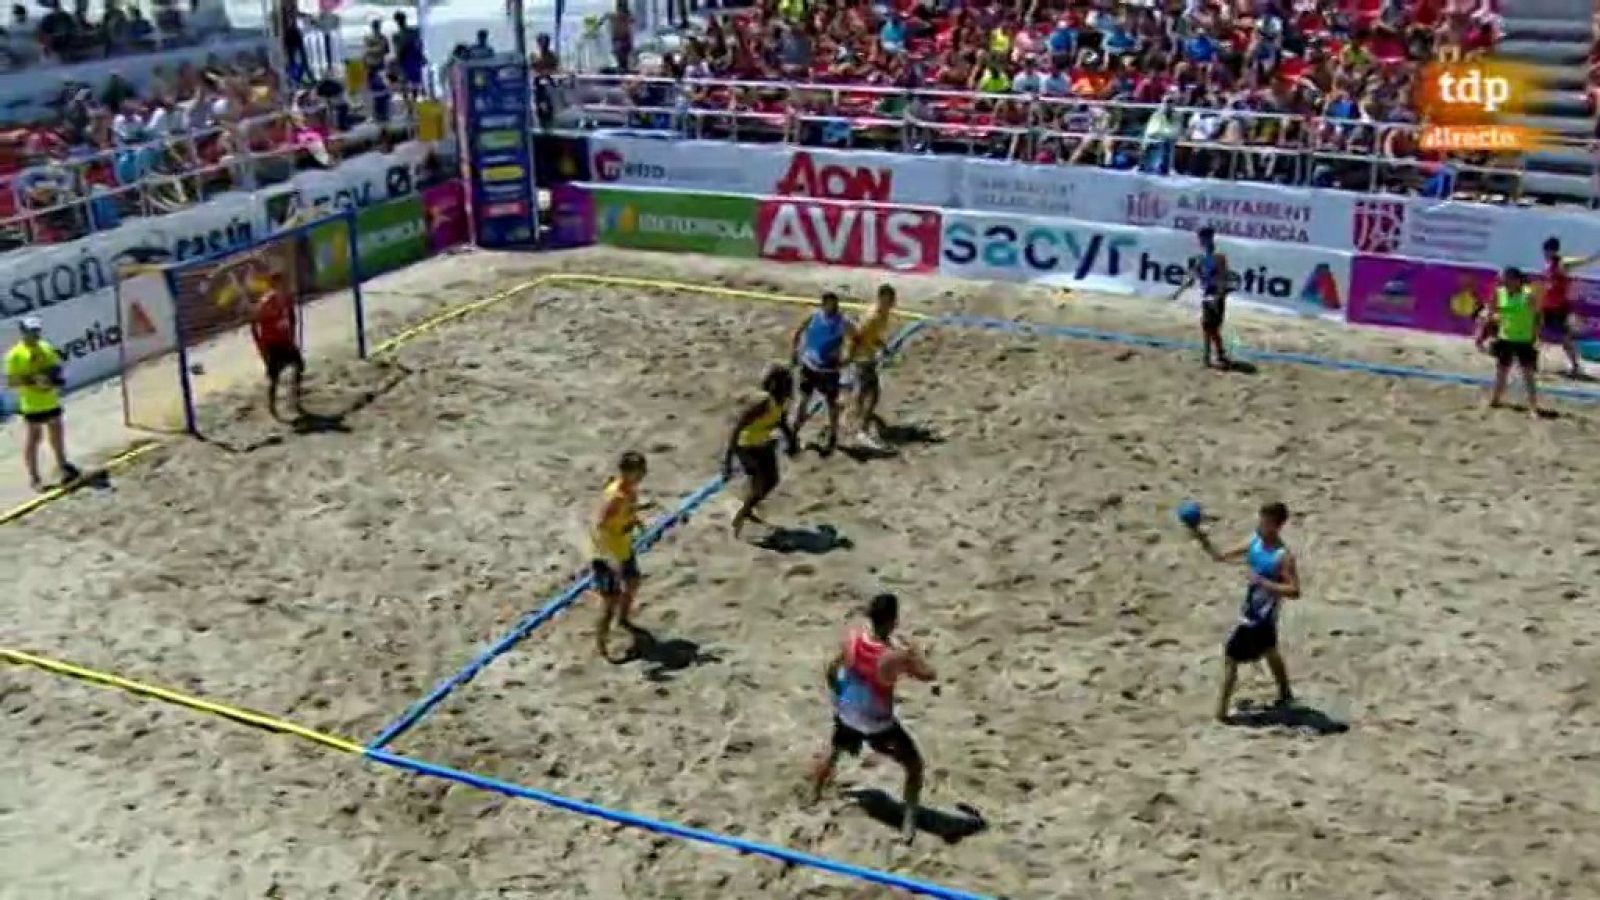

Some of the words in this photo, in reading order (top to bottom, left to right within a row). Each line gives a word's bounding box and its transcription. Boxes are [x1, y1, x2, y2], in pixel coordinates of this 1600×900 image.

[763, 203, 922, 270] AVIS
[944, 221, 1138, 280] sacyr
[1138, 252, 1292, 298] heletia
